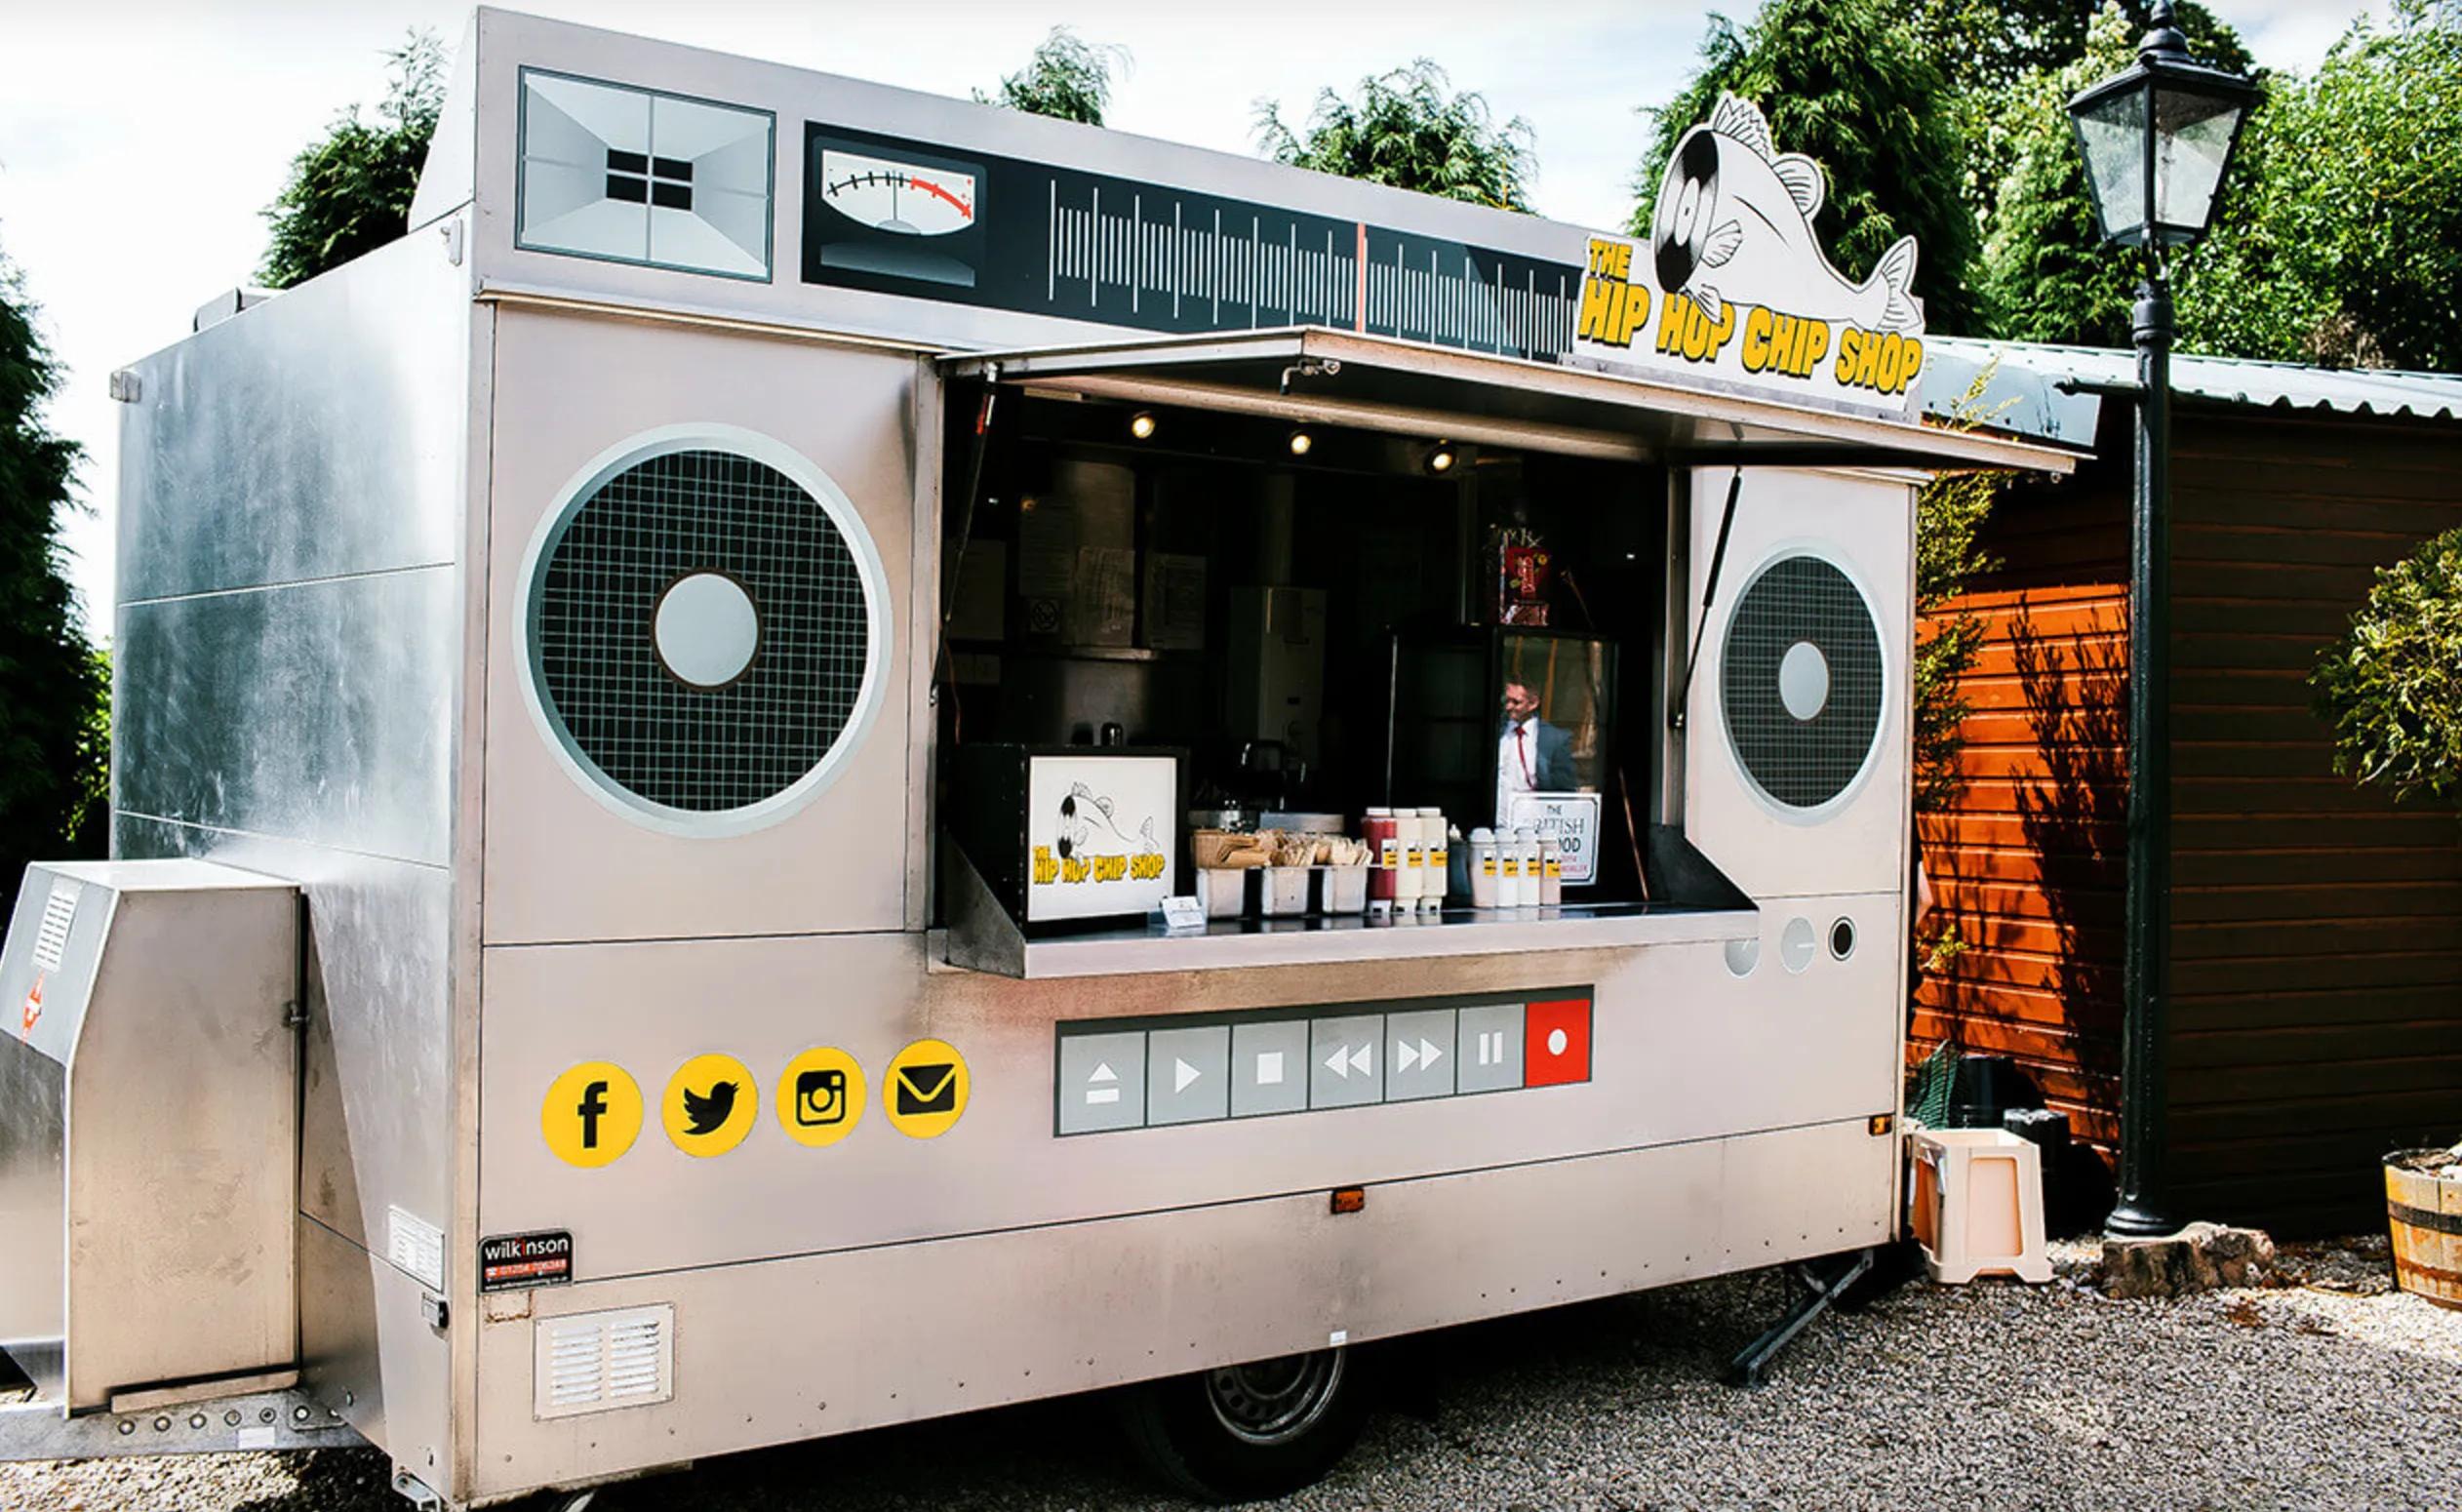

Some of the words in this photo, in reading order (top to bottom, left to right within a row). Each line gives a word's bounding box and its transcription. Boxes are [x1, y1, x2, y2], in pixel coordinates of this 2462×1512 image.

[1589, 239, 1633, 280] THE
[1577, 277, 1650, 347] HIP
[1656, 292, 1736, 362] HOP
[1742, 305, 1830, 378] CHIP
[1835, 327, 1924, 393] SHOP
[1033, 857, 1059, 884] HIP
[1061, 857, 1091, 883] HOP
[1093, 855, 1128, 883] CHIP
[1131, 854, 1166, 880] SHOP
[485, 1237, 569, 1260] wilkinson
